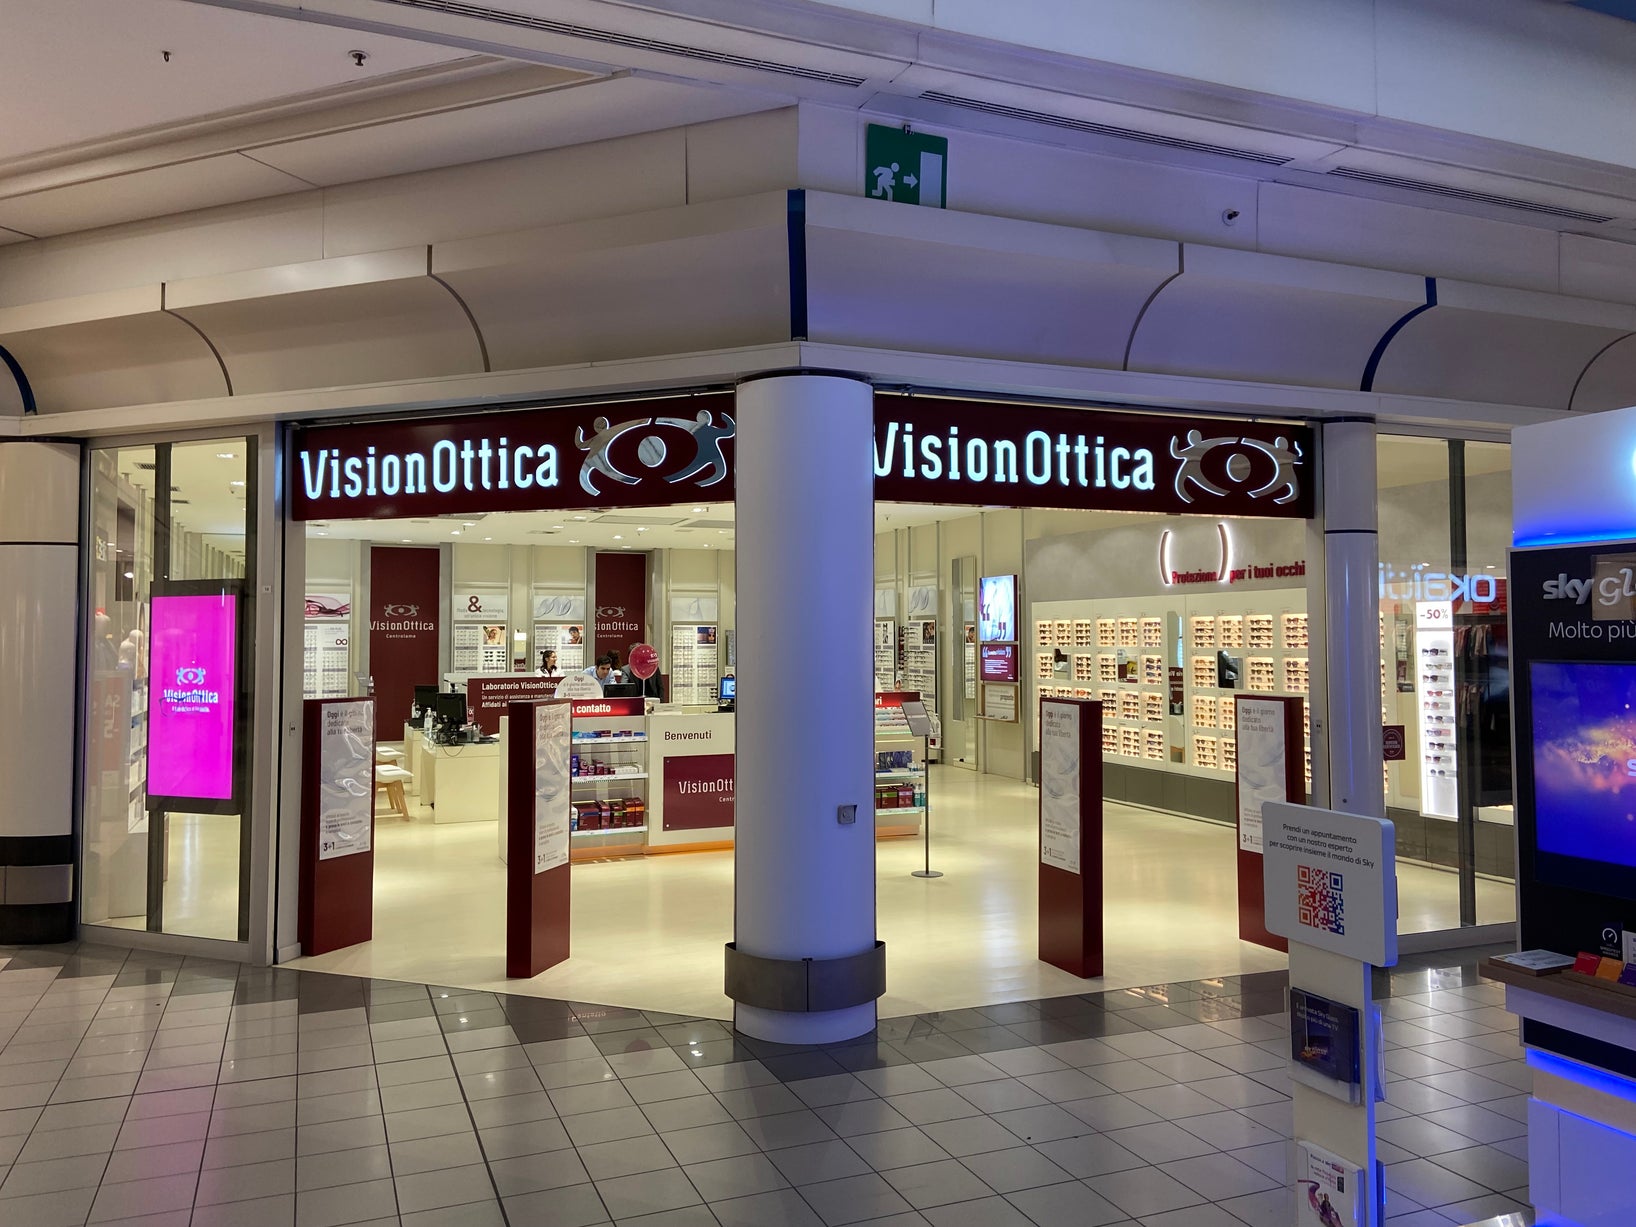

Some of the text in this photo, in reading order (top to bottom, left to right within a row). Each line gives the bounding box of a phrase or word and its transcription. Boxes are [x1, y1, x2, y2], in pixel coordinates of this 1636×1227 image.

[874, 422, 1155, 491] VisionOttica
[300, 437, 559, 500] VisionOttica
[1172, 569, 1217, 584] Protezione
[1230, 569, 1246, 584] per
[1254, 563, 1273, 578] tuoi
[1276, 561, 1305, 577] occhi
[1542, 568, 1636, 606] sky gl
[370, 620, 434, 631] VisionOttica
[594, 621, 639, 631] sionOttica
[1549, 621, 1603, 639] Molto
[482, 681, 558, 691] Laboratorio VisionOttica
[576, 703, 611, 714] contatto
[664, 730, 712, 741] Benvenuti
[678, 779, 734, 794] VisionOtt
[1282, 823, 1301, 833] Prendi
[1310, 830, 1357, 844] appuntamento
[323, 842, 335, 852] 3+1
[1307, 839, 1327, 848] nostro
[1327, 842, 1353, 853] esperto
[1269, 840, 1279, 848] per
[1279, 841, 1303, 852] scoprire
[1303, 846, 1326, 858] insieme
[1327, 851, 1331, 859] il
[1331, 853, 1354, 864] mondo
[1355, 856, 1362, 865] di
[1362, 858, 1375, 869] Sky
